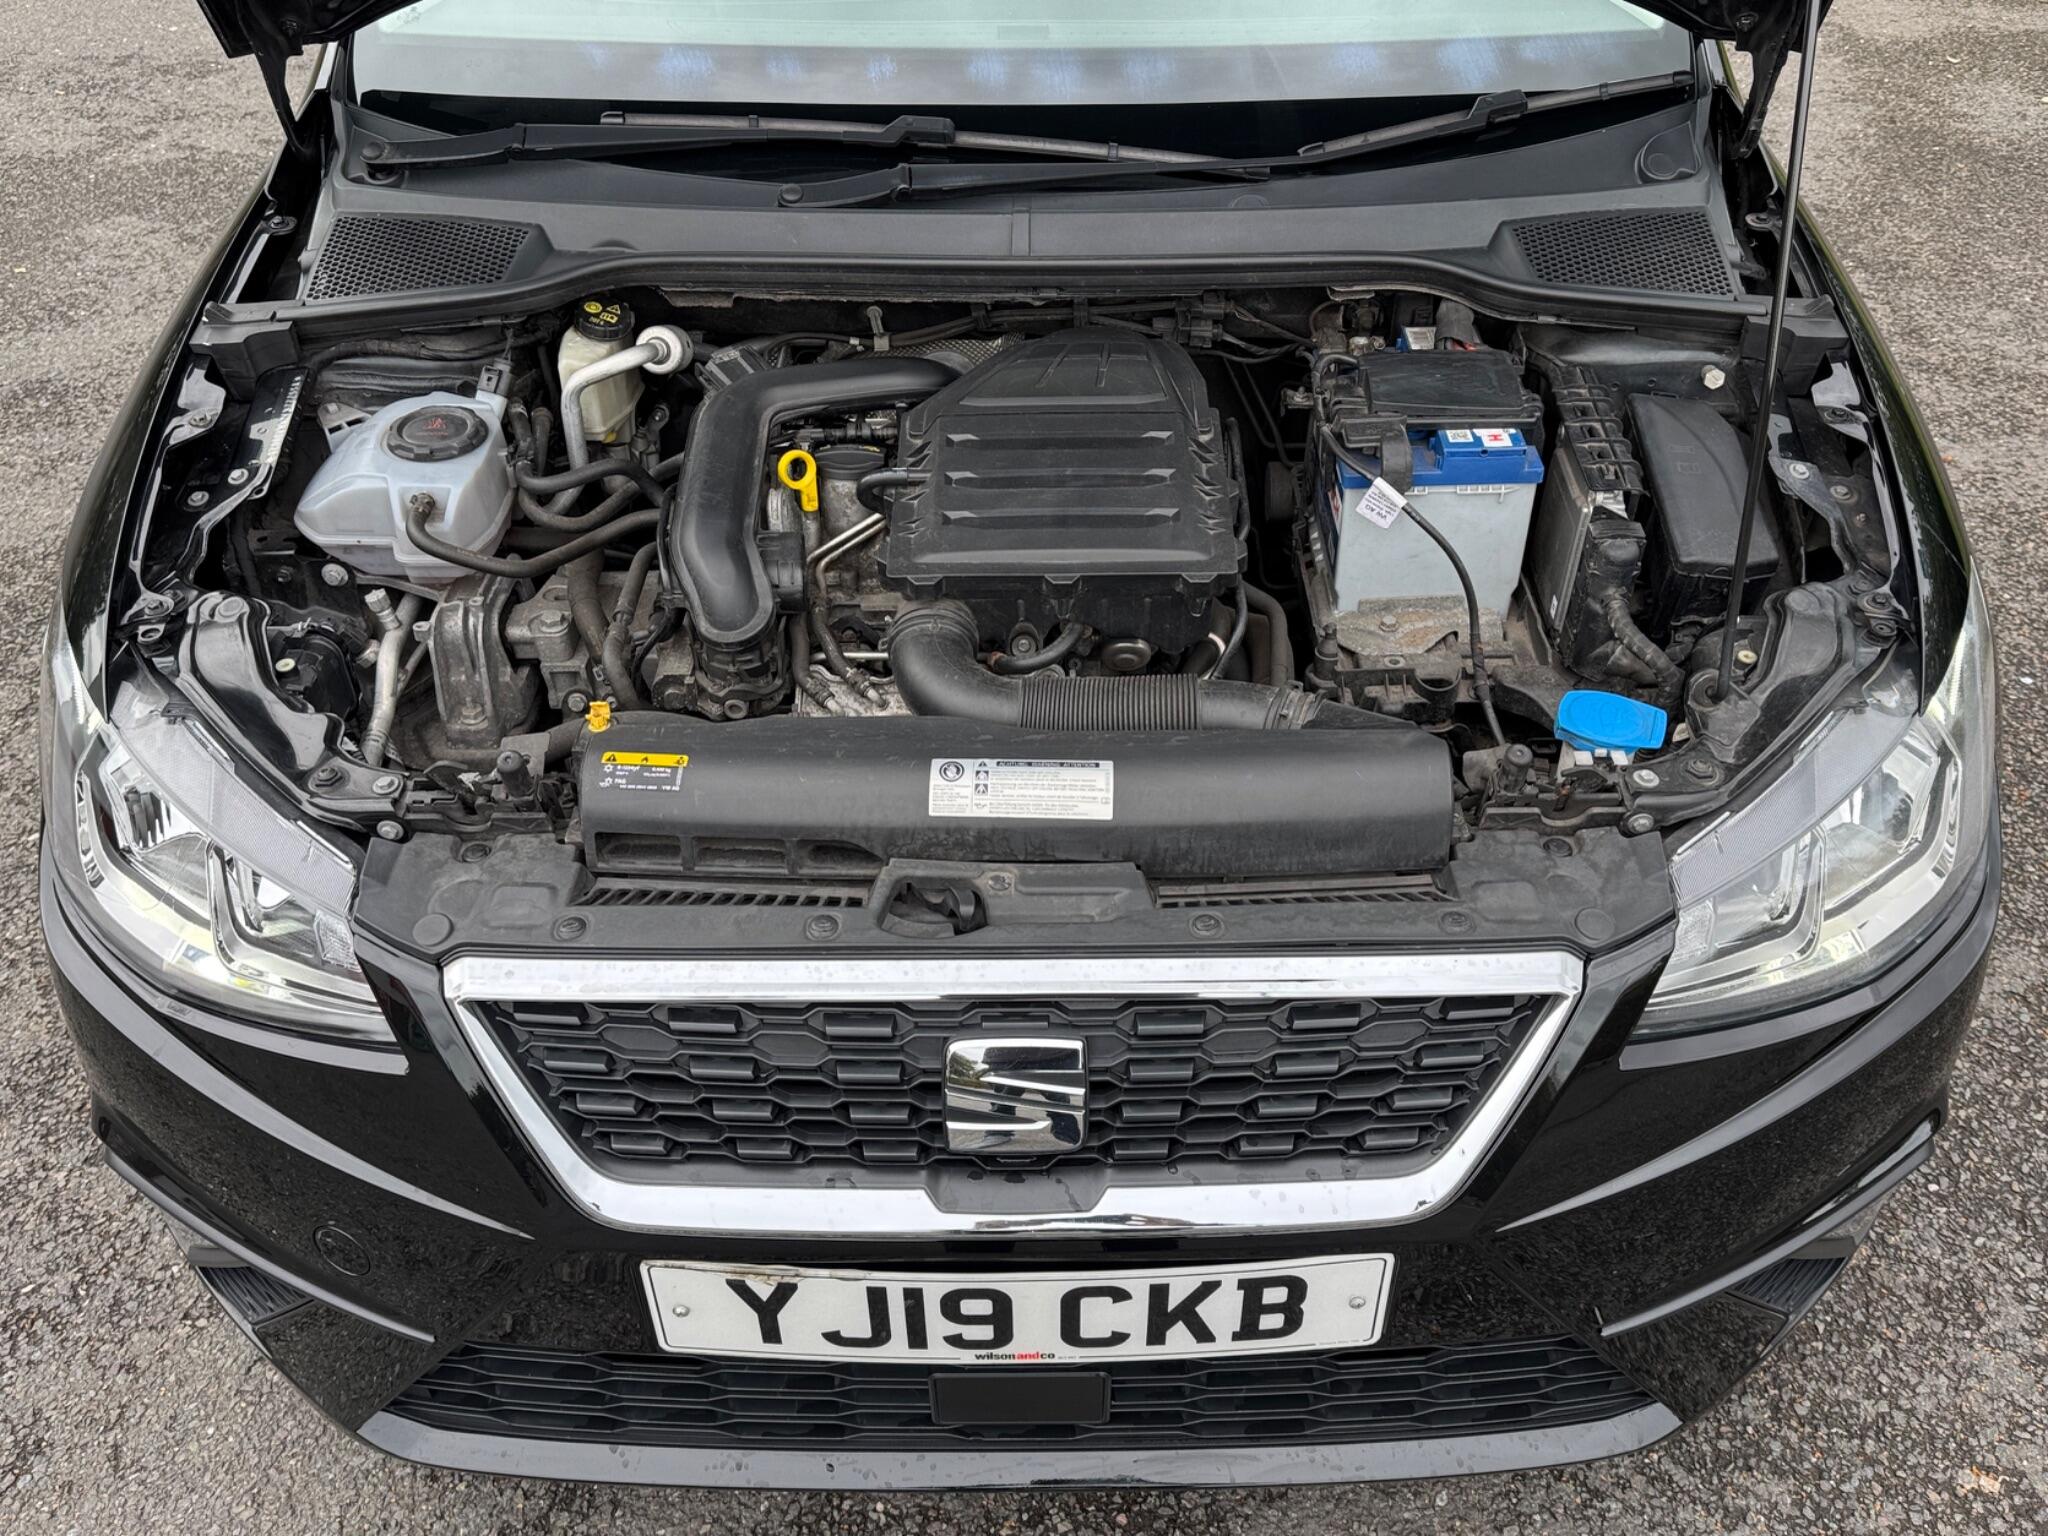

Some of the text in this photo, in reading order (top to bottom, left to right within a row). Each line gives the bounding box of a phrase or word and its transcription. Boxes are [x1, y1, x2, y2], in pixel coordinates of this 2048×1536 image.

[727, 1275, 1308, 1348] YJ19 CKB
[974, 1351, 1056, 1361] wilsonandco
